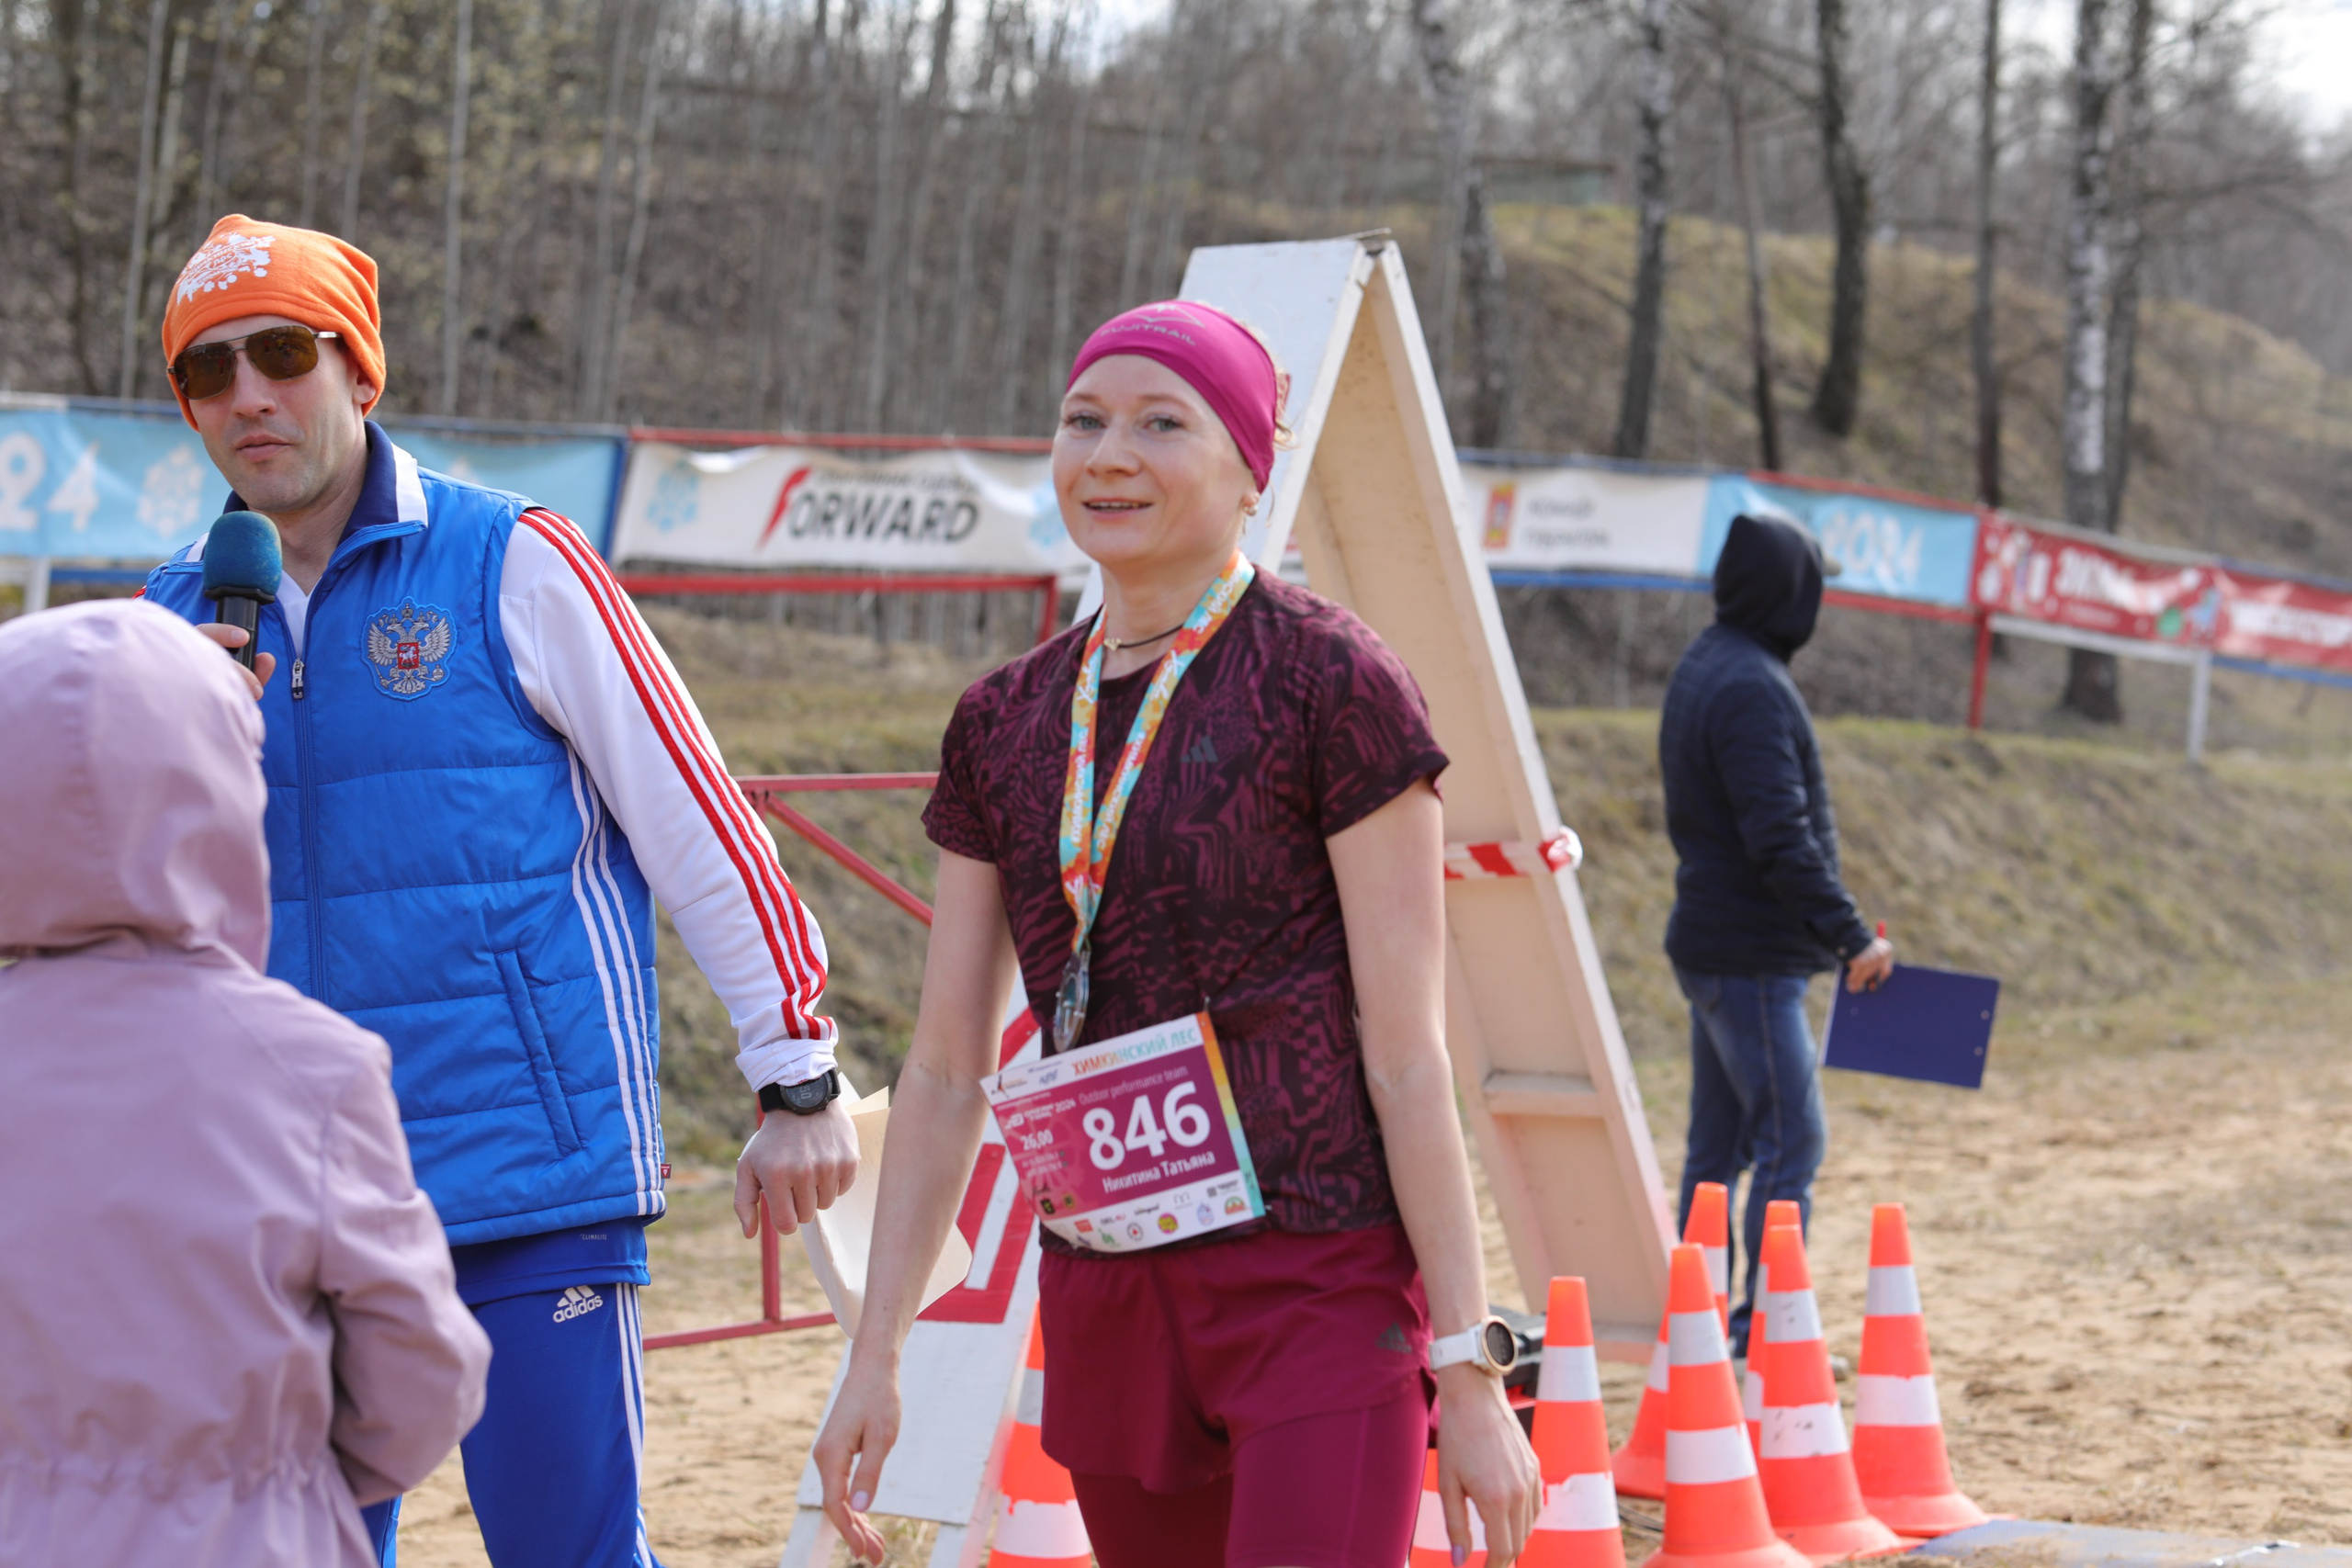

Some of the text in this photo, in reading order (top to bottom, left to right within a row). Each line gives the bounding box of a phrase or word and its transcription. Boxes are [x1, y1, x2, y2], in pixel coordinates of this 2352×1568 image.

[755, 464, 980, 552] FORWARD
[1170, 1027, 1197, 1048] ЛЕС
[1163, 1066, 1189, 1084] team
[1082, 1080, 1211, 1170] 846
[1102, 1151, 1216, 1193] Никитина Татьяна
[552, 1294, 604, 1324] adidas
